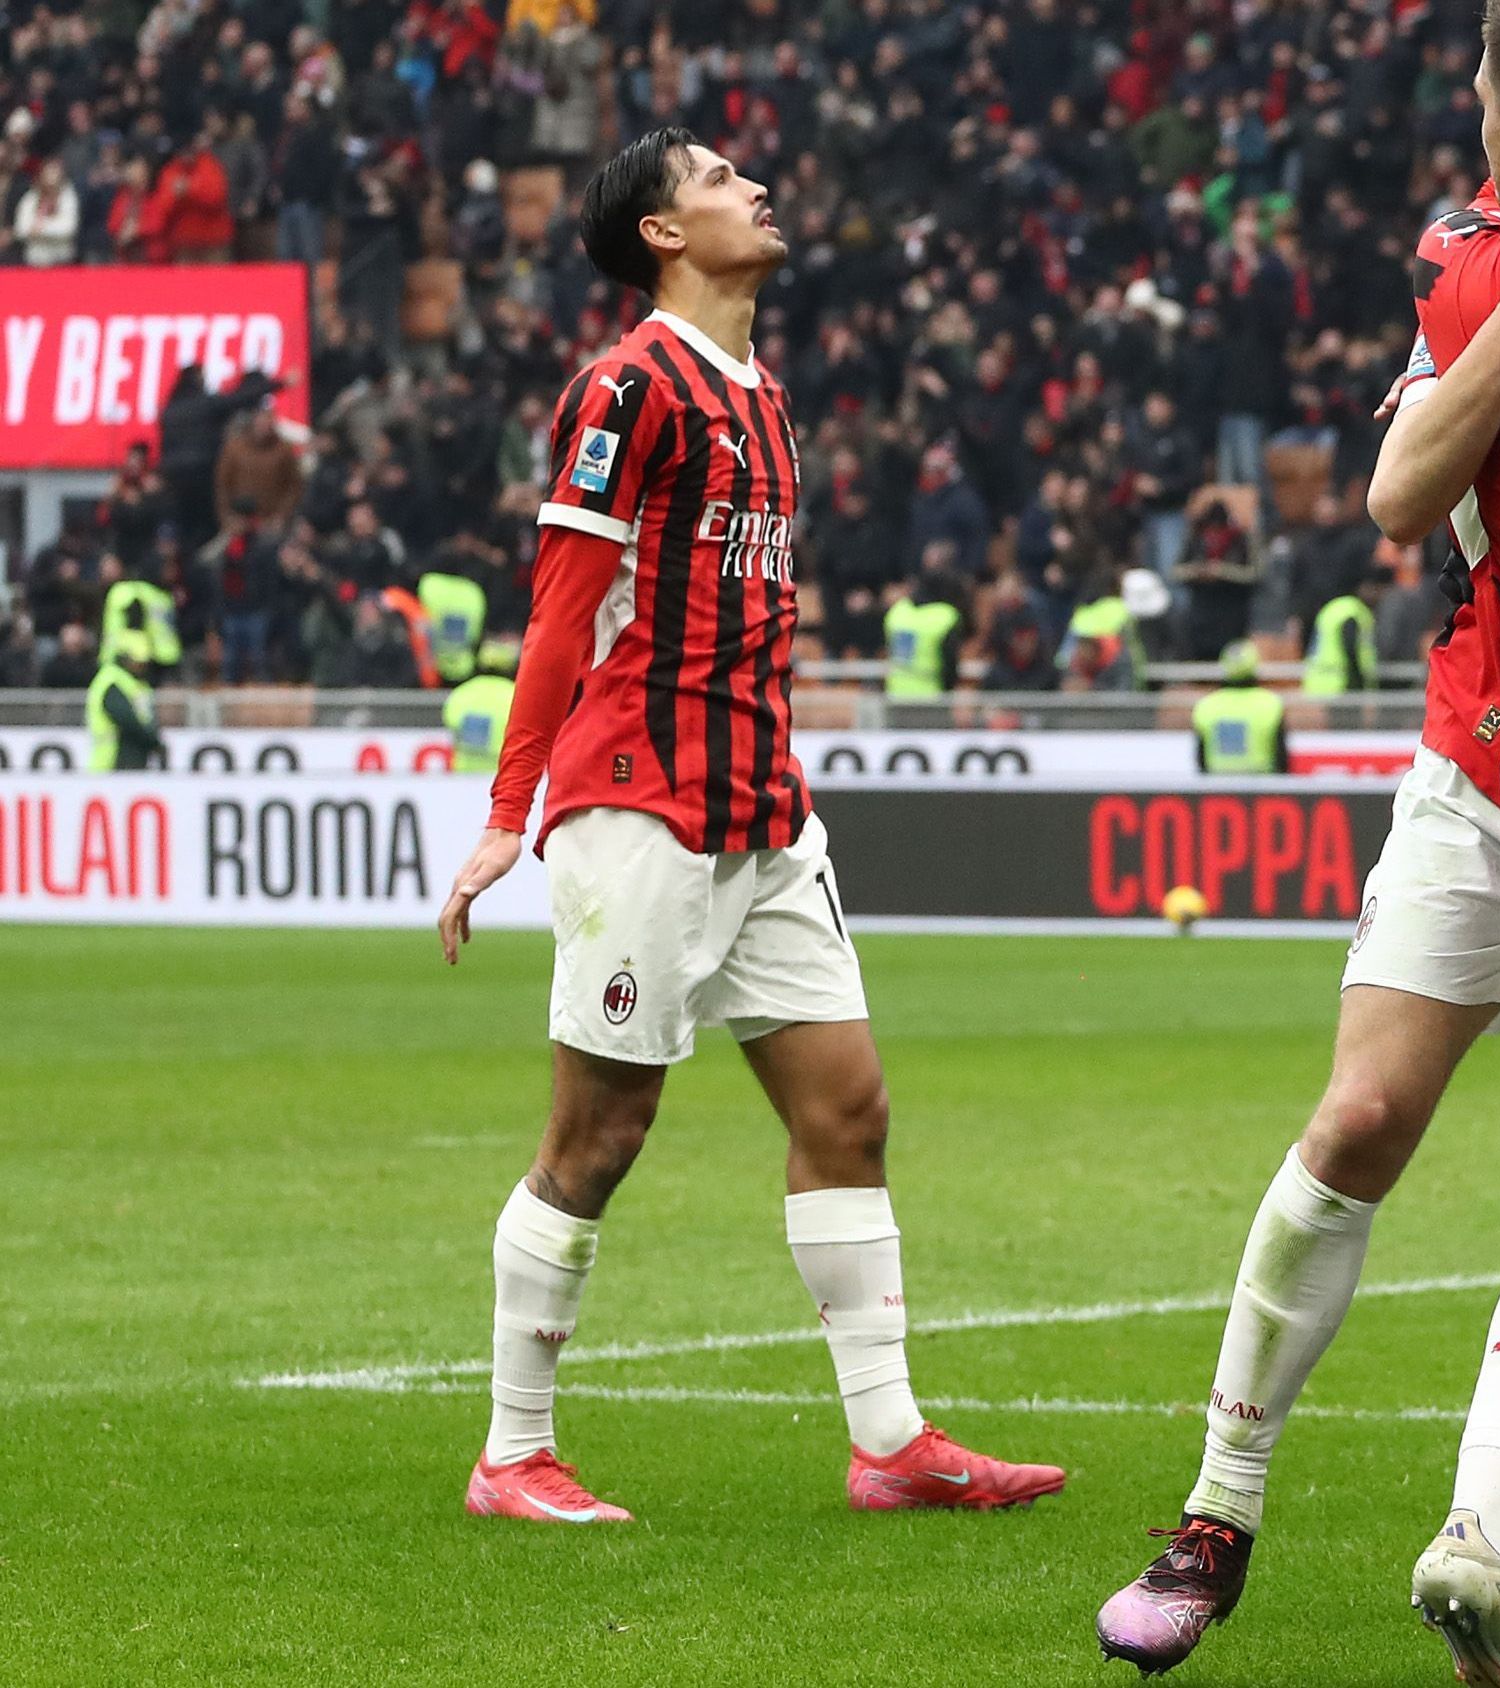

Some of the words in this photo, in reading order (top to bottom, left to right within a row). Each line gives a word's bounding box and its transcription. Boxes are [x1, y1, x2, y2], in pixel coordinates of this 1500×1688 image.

[721, 541, 759, 578] FLY
[0, 797, 169, 897] ILAN
[206, 798, 429, 899] ROMA
[1088, 794, 1360, 919] COPPA
